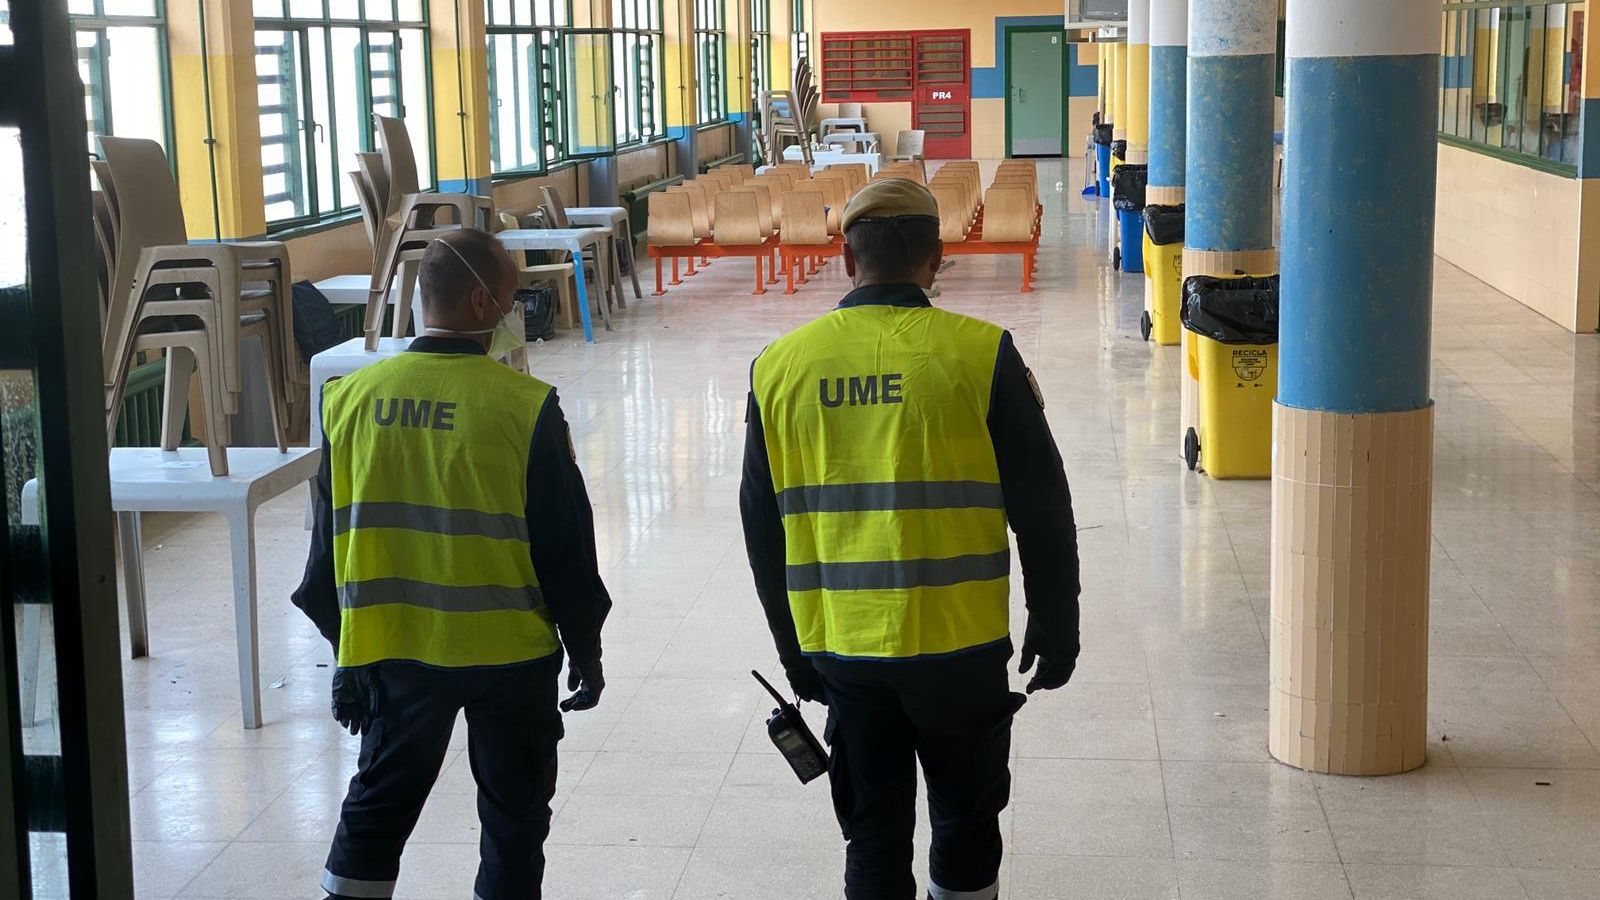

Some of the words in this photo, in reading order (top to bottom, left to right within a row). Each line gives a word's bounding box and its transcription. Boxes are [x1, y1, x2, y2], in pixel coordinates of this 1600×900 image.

[932, 91, 952, 99] PR4
[819, 373, 902, 408] UME
[374, 398, 457, 430] UME
